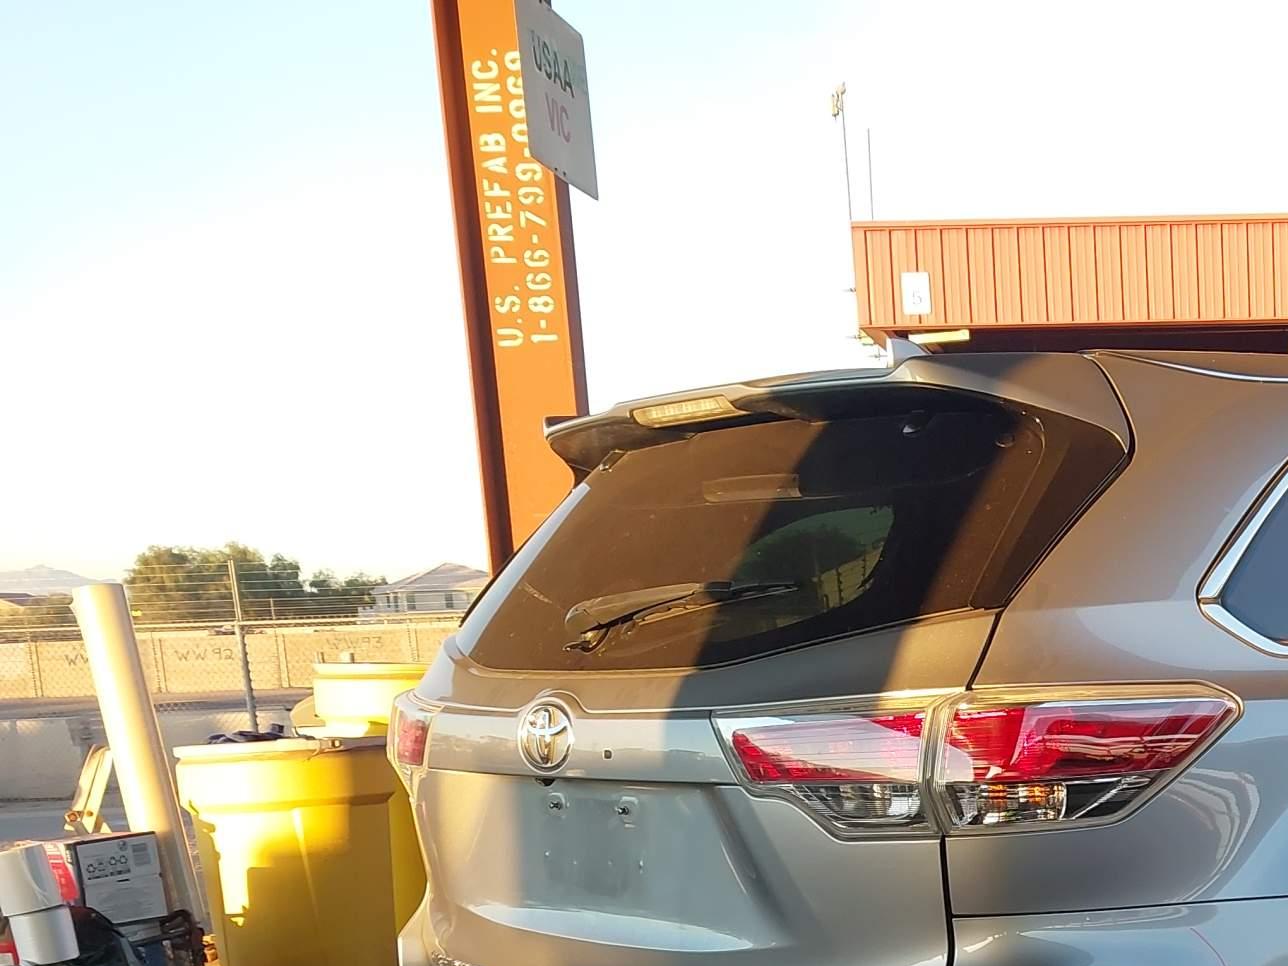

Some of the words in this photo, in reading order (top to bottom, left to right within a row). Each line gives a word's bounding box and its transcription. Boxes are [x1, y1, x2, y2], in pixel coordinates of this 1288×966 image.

[471, 48, 503, 112] INC.
[532, 35, 575, 99] USAA
[545, 92, 571, 143] VIC
[480, 132, 517, 264] PREFAB
[494, 284, 524, 348] U.S.
[212, 648, 235, 661] 92
